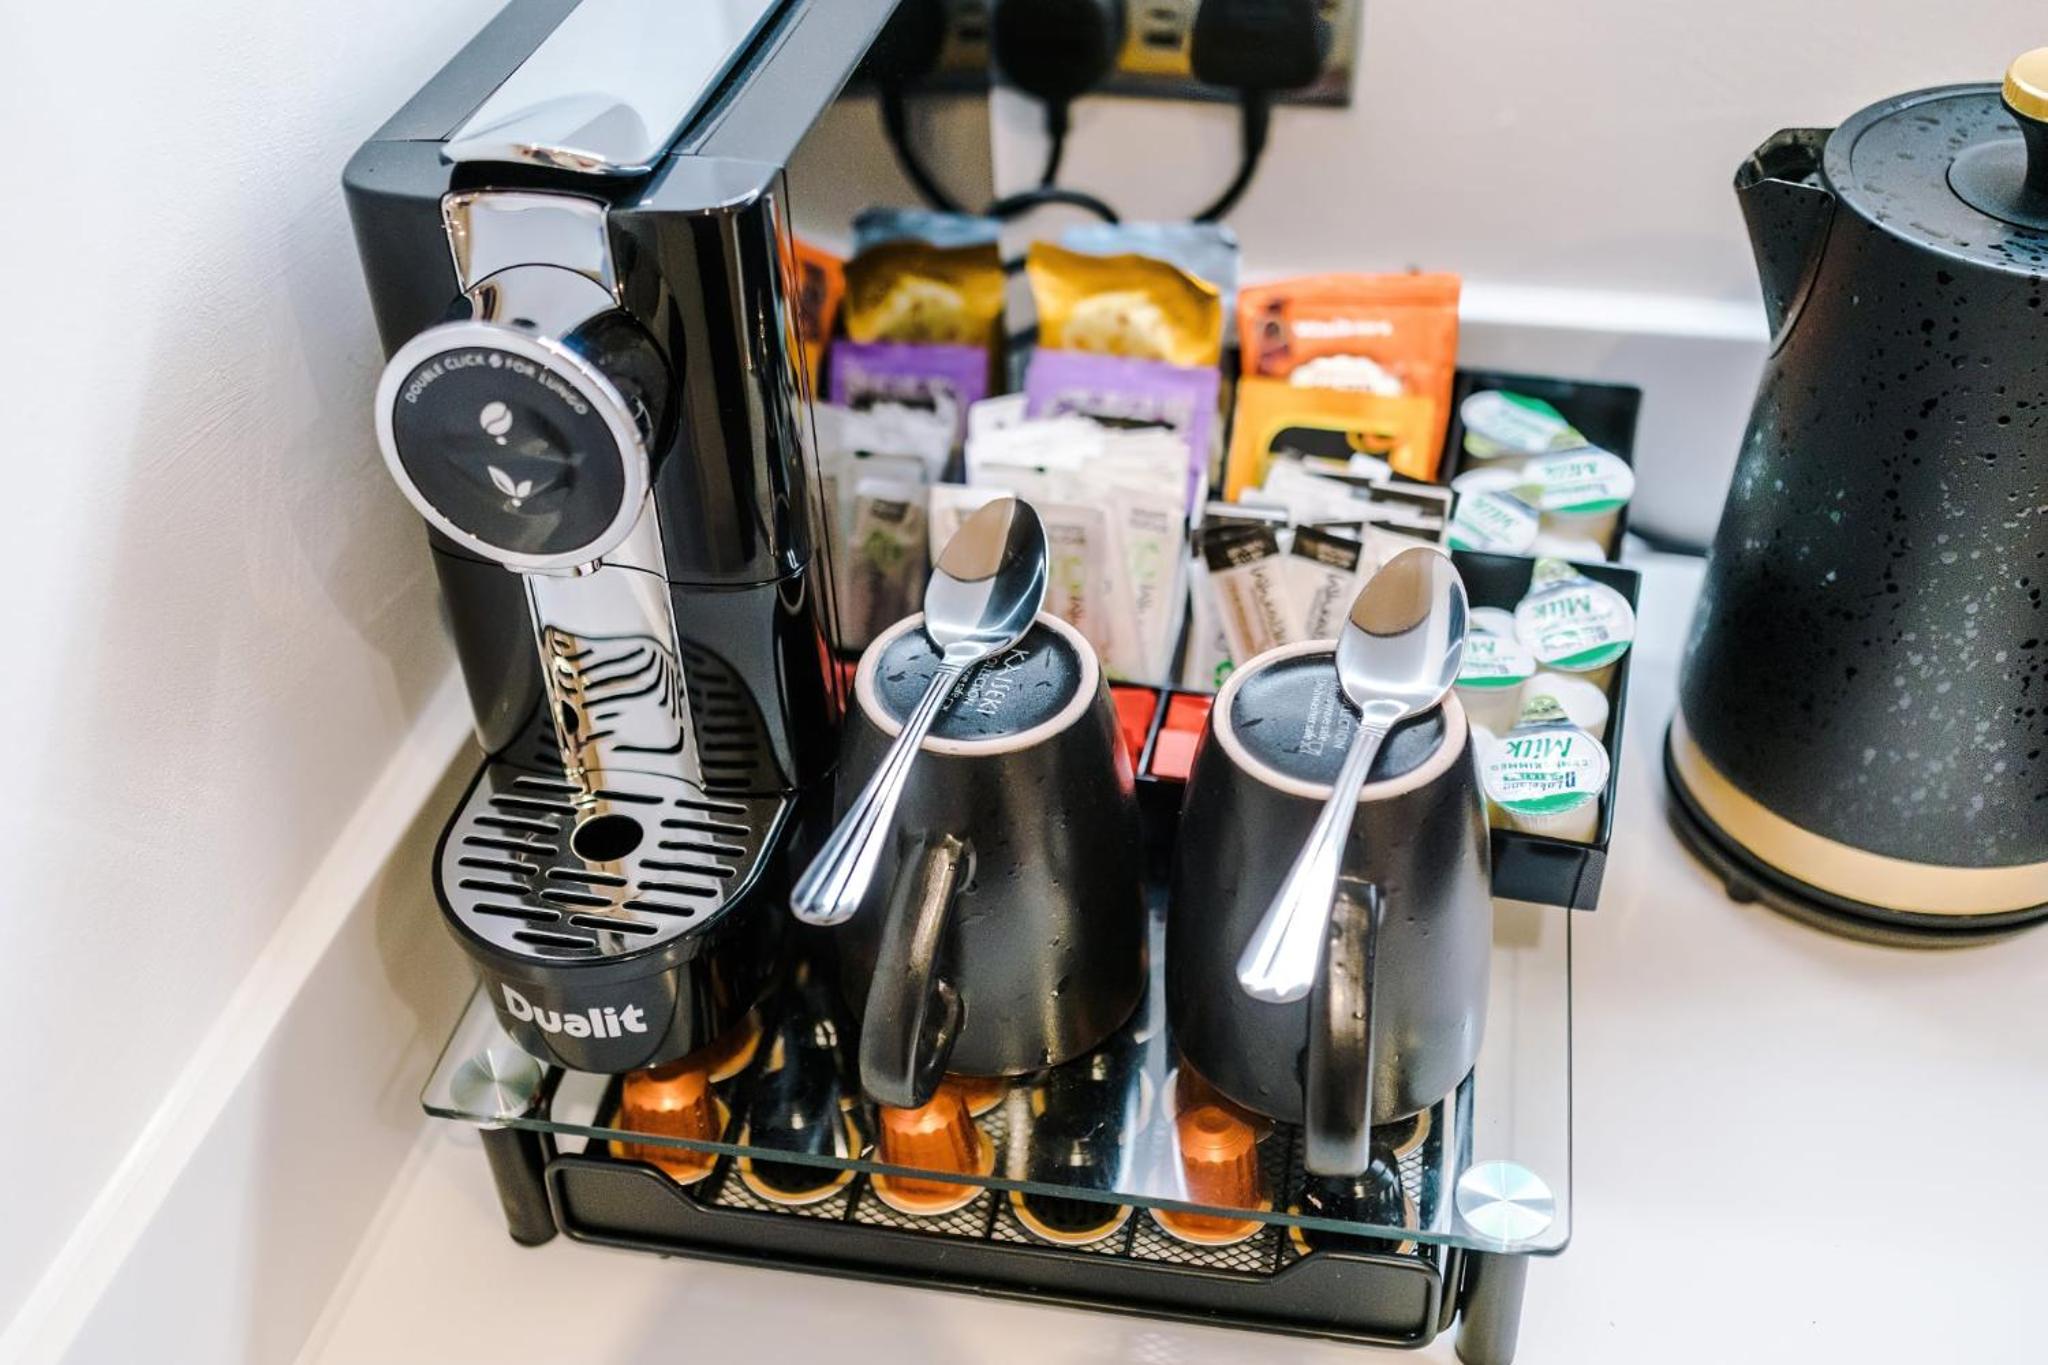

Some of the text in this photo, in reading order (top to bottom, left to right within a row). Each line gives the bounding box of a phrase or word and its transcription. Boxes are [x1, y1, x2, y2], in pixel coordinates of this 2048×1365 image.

[405, 354, 588, 415] DOUBLE CLICK FOR LUNGO
[1506, 736, 1572, 759] Milk
[501, 983, 648, 1039] Dualit
